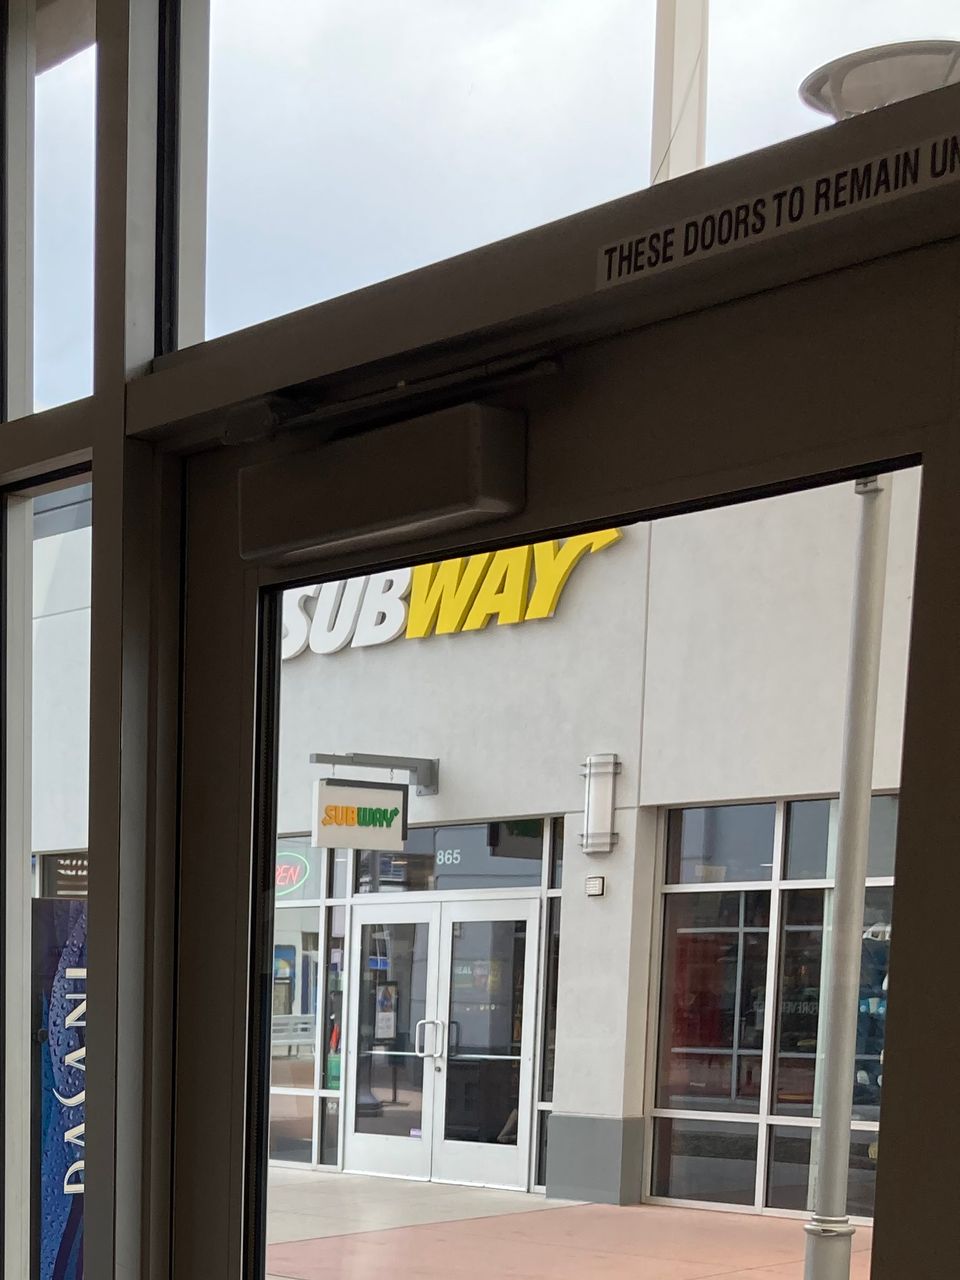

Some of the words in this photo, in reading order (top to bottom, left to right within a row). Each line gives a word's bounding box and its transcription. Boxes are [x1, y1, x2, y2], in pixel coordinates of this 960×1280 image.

[604, 228, 675, 281] THESE
[683, 198, 766, 257] DOORS
[773, 186, 804, 228] TO
[814, 148, 920, 215] REMAIN
[321, 804, 400, 828] SUBWAY
[436, 849, 461, 865] 865
